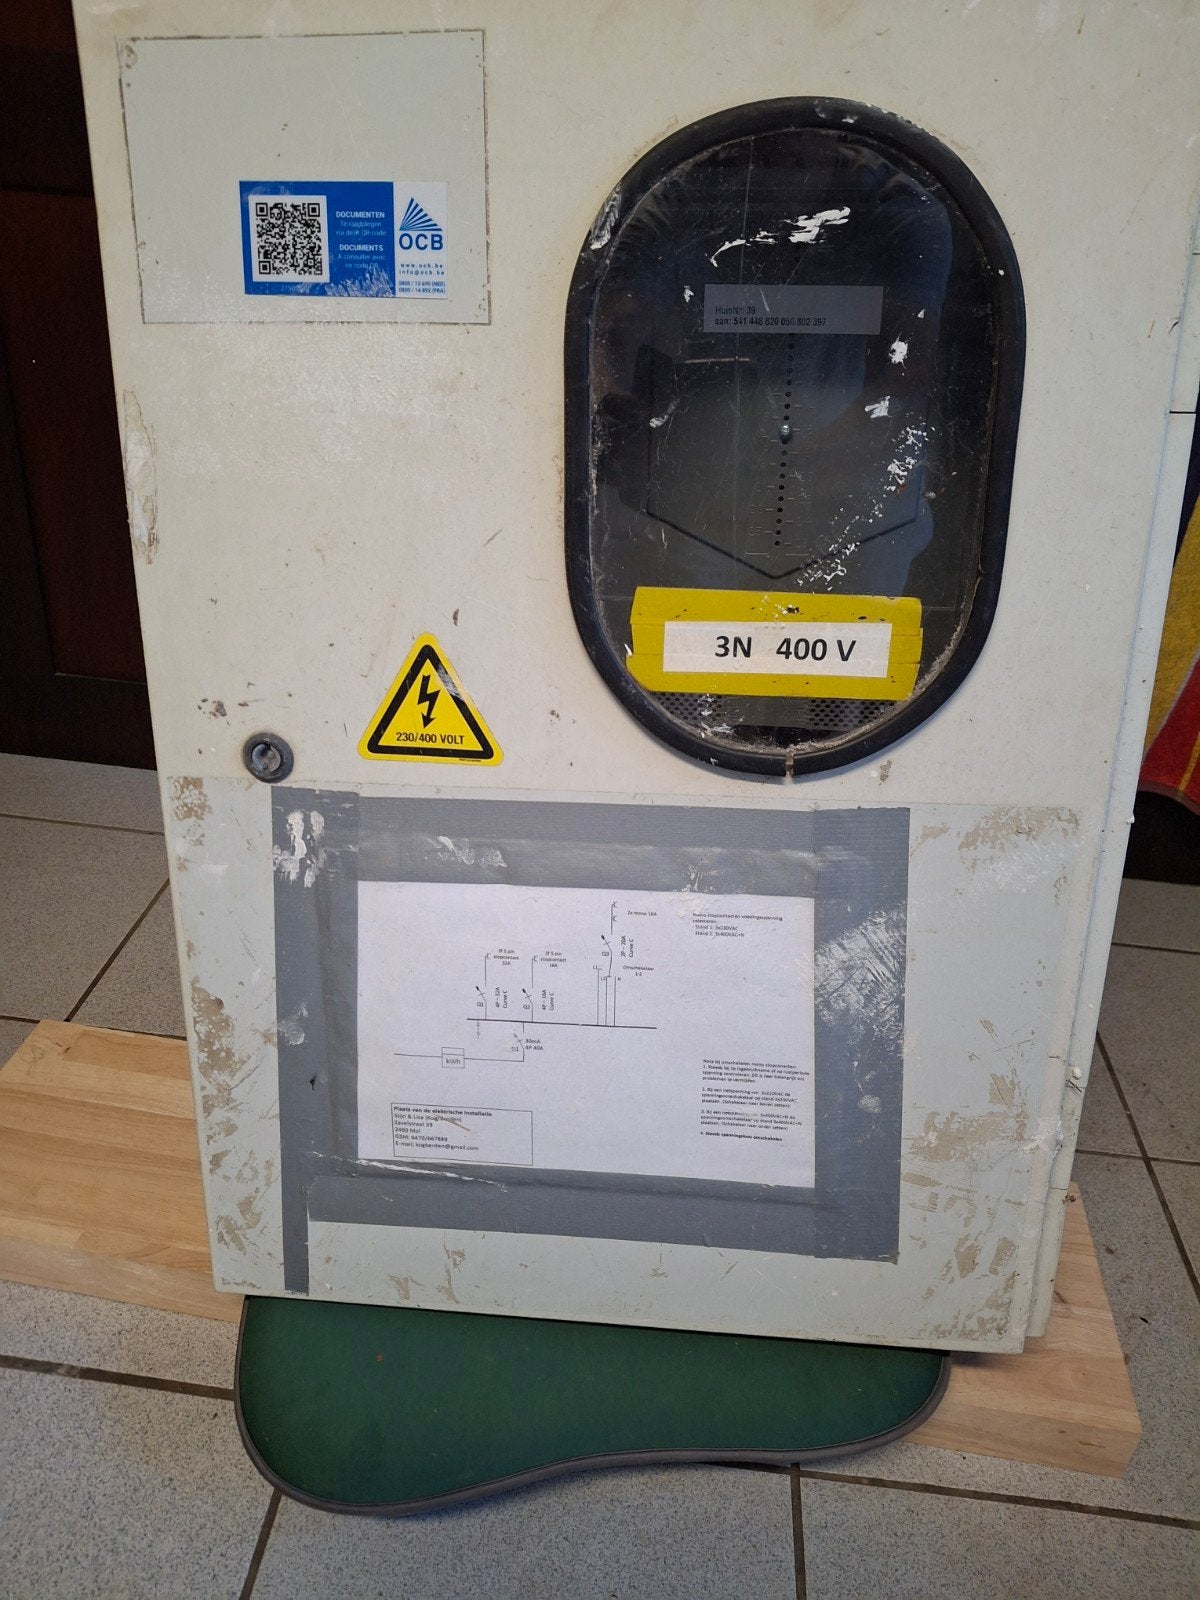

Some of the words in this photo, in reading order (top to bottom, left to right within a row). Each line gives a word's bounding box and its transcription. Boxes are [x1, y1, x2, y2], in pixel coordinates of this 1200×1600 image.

[339, 243, 384, 252] DOCUMENTS
[398, 233, 444, 251] OCB
[746, 306, 757, 315] 39
[714, 317, 731, 326] ean:
[733, 317, 747, 326] 541
[812, 317, 828, 327] 397
[714, 635, 752, 659] 3N
[775, 637, 828, 661] 400
[836, 639, 857, 662] V
[395, 732, 437, 744] 230/400
[439, 734, 465, 745] VOLT
